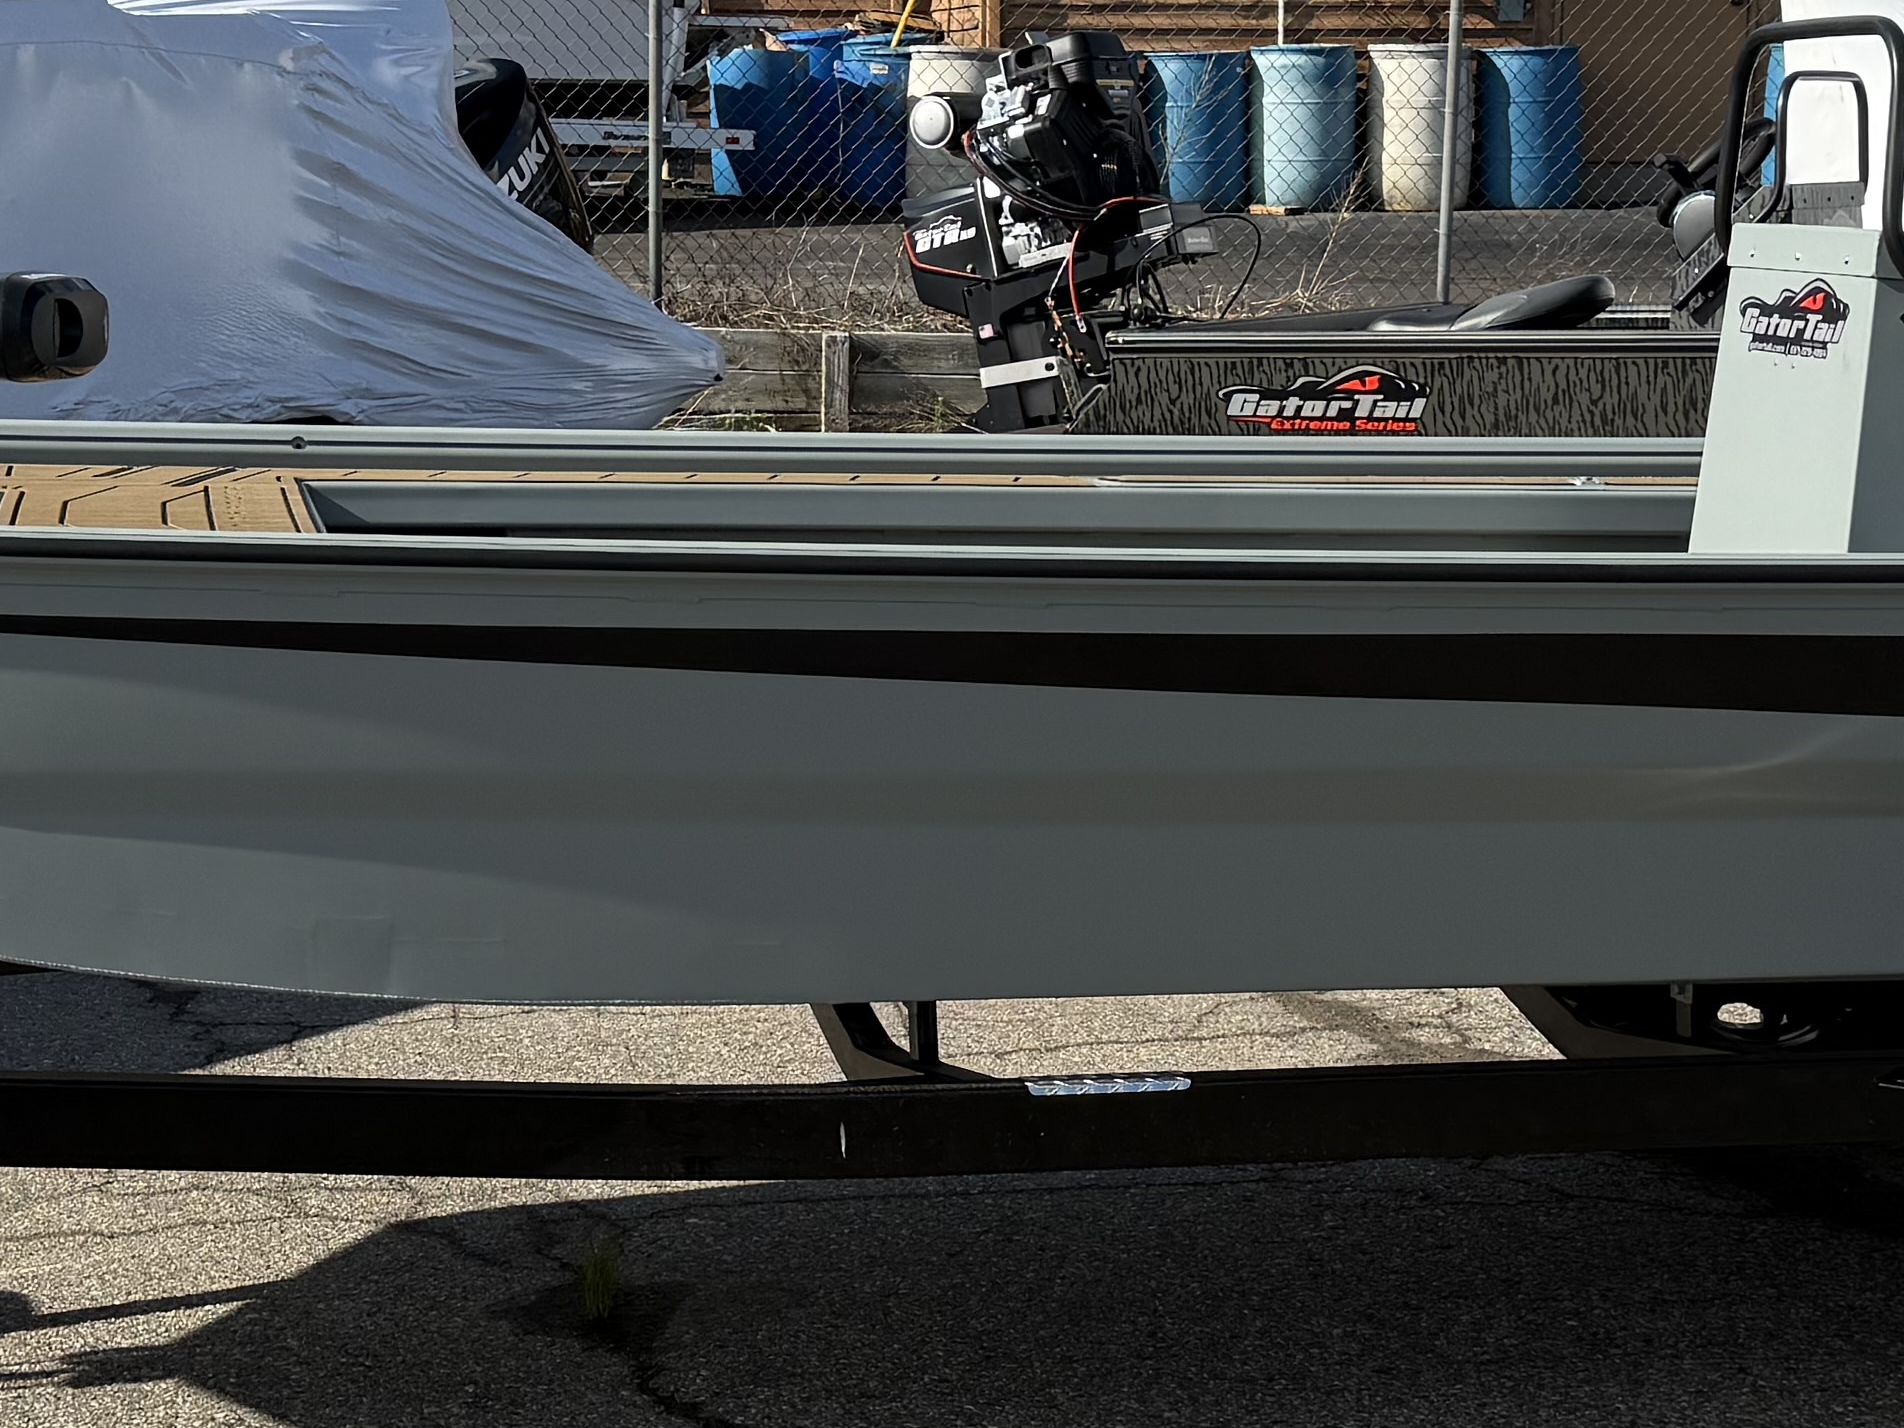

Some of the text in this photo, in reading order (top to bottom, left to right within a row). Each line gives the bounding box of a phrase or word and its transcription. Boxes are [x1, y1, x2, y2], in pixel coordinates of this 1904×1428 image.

[1740, 306, 1846, 344] GatorTail
[1226, 392, 1428, 419] GatorTail
[1269, 417, 1418, 433] Extreme Series
